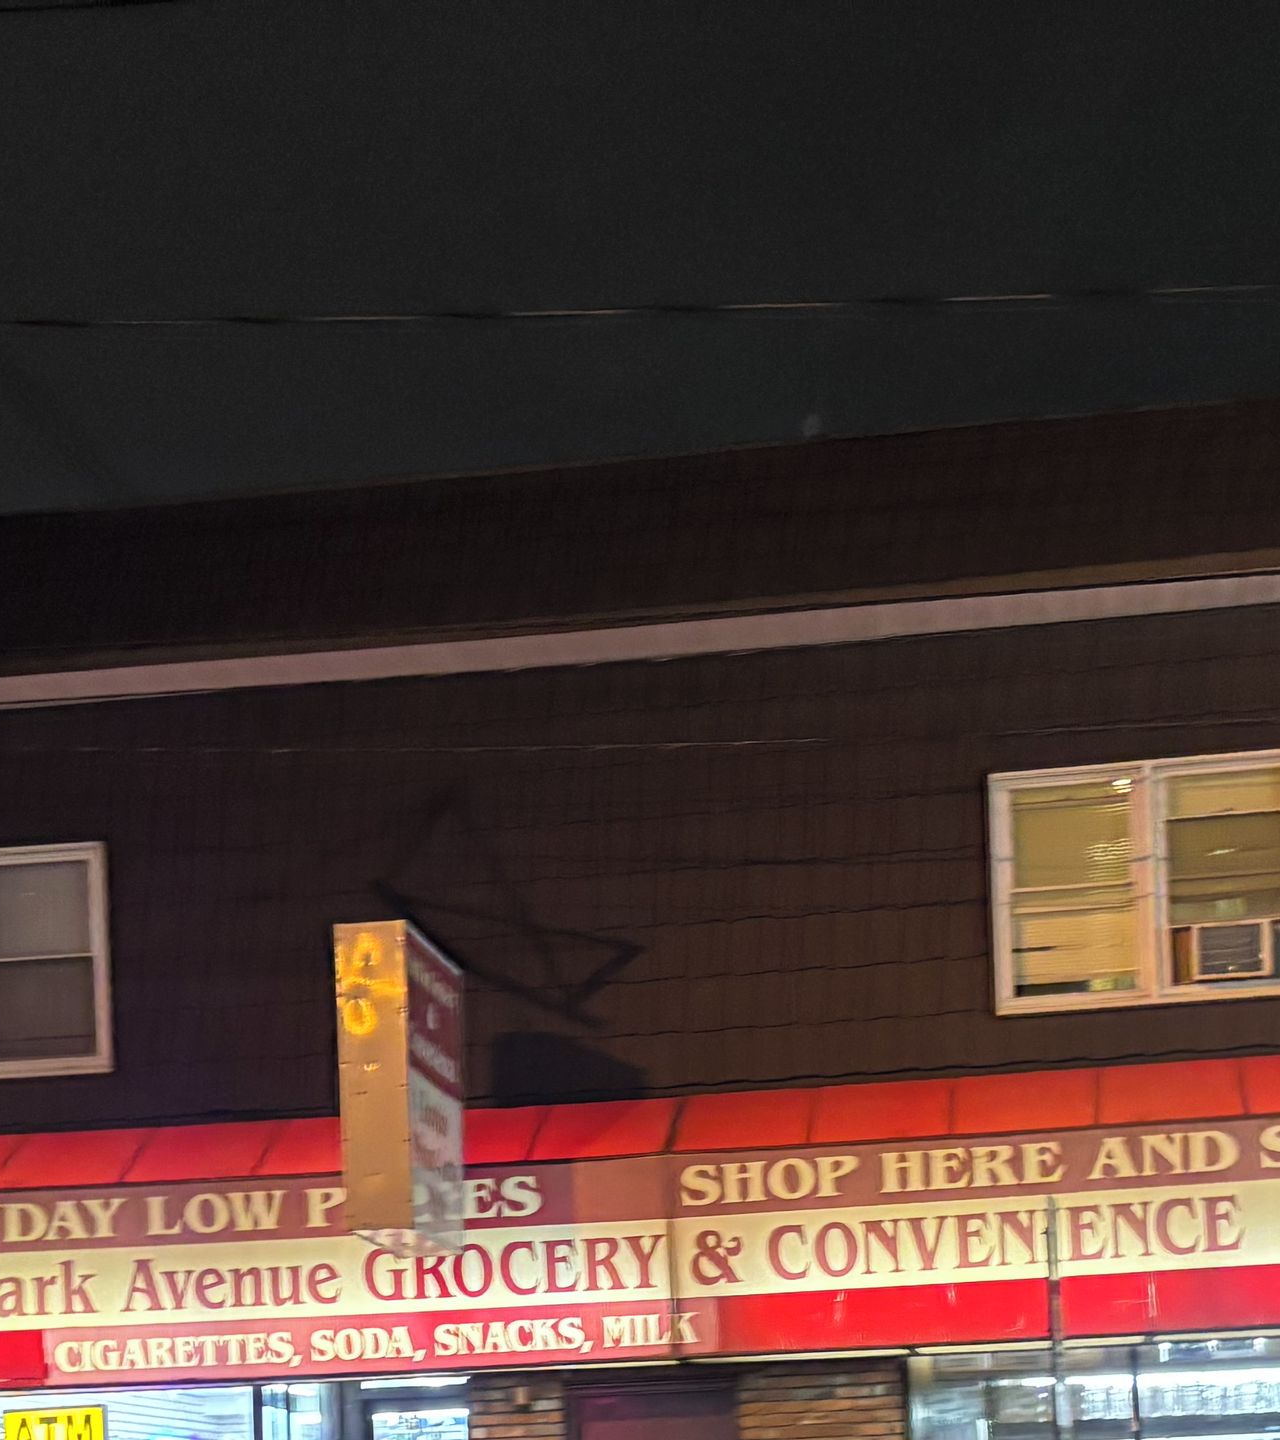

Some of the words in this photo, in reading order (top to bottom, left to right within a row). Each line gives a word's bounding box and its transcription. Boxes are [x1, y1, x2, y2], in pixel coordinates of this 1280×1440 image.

[681, 1152, 861, 1206] SHOP
[878, 1139, 1070, 1195] HERE
[1088, 1129, 1241, 1182] AND
[146, 1189, 286, 1237] LOW
[306, 1175, 544, 1228] PES
[120, 1257, 342, 1313] Avenue
[364, 1234, 667, 1301] GROCERY
[691, 1229, 745, 1286] &
[768, 1195, 1246, 1281] CONVENIENCE
[54, 1330, 302, 1375] CIGARETTES,
[310, 1325, 427, 1362] SODA,
[434, 1316, 594, 1357] SNACKS,
[603, 1311, 701, 1348] MILK
